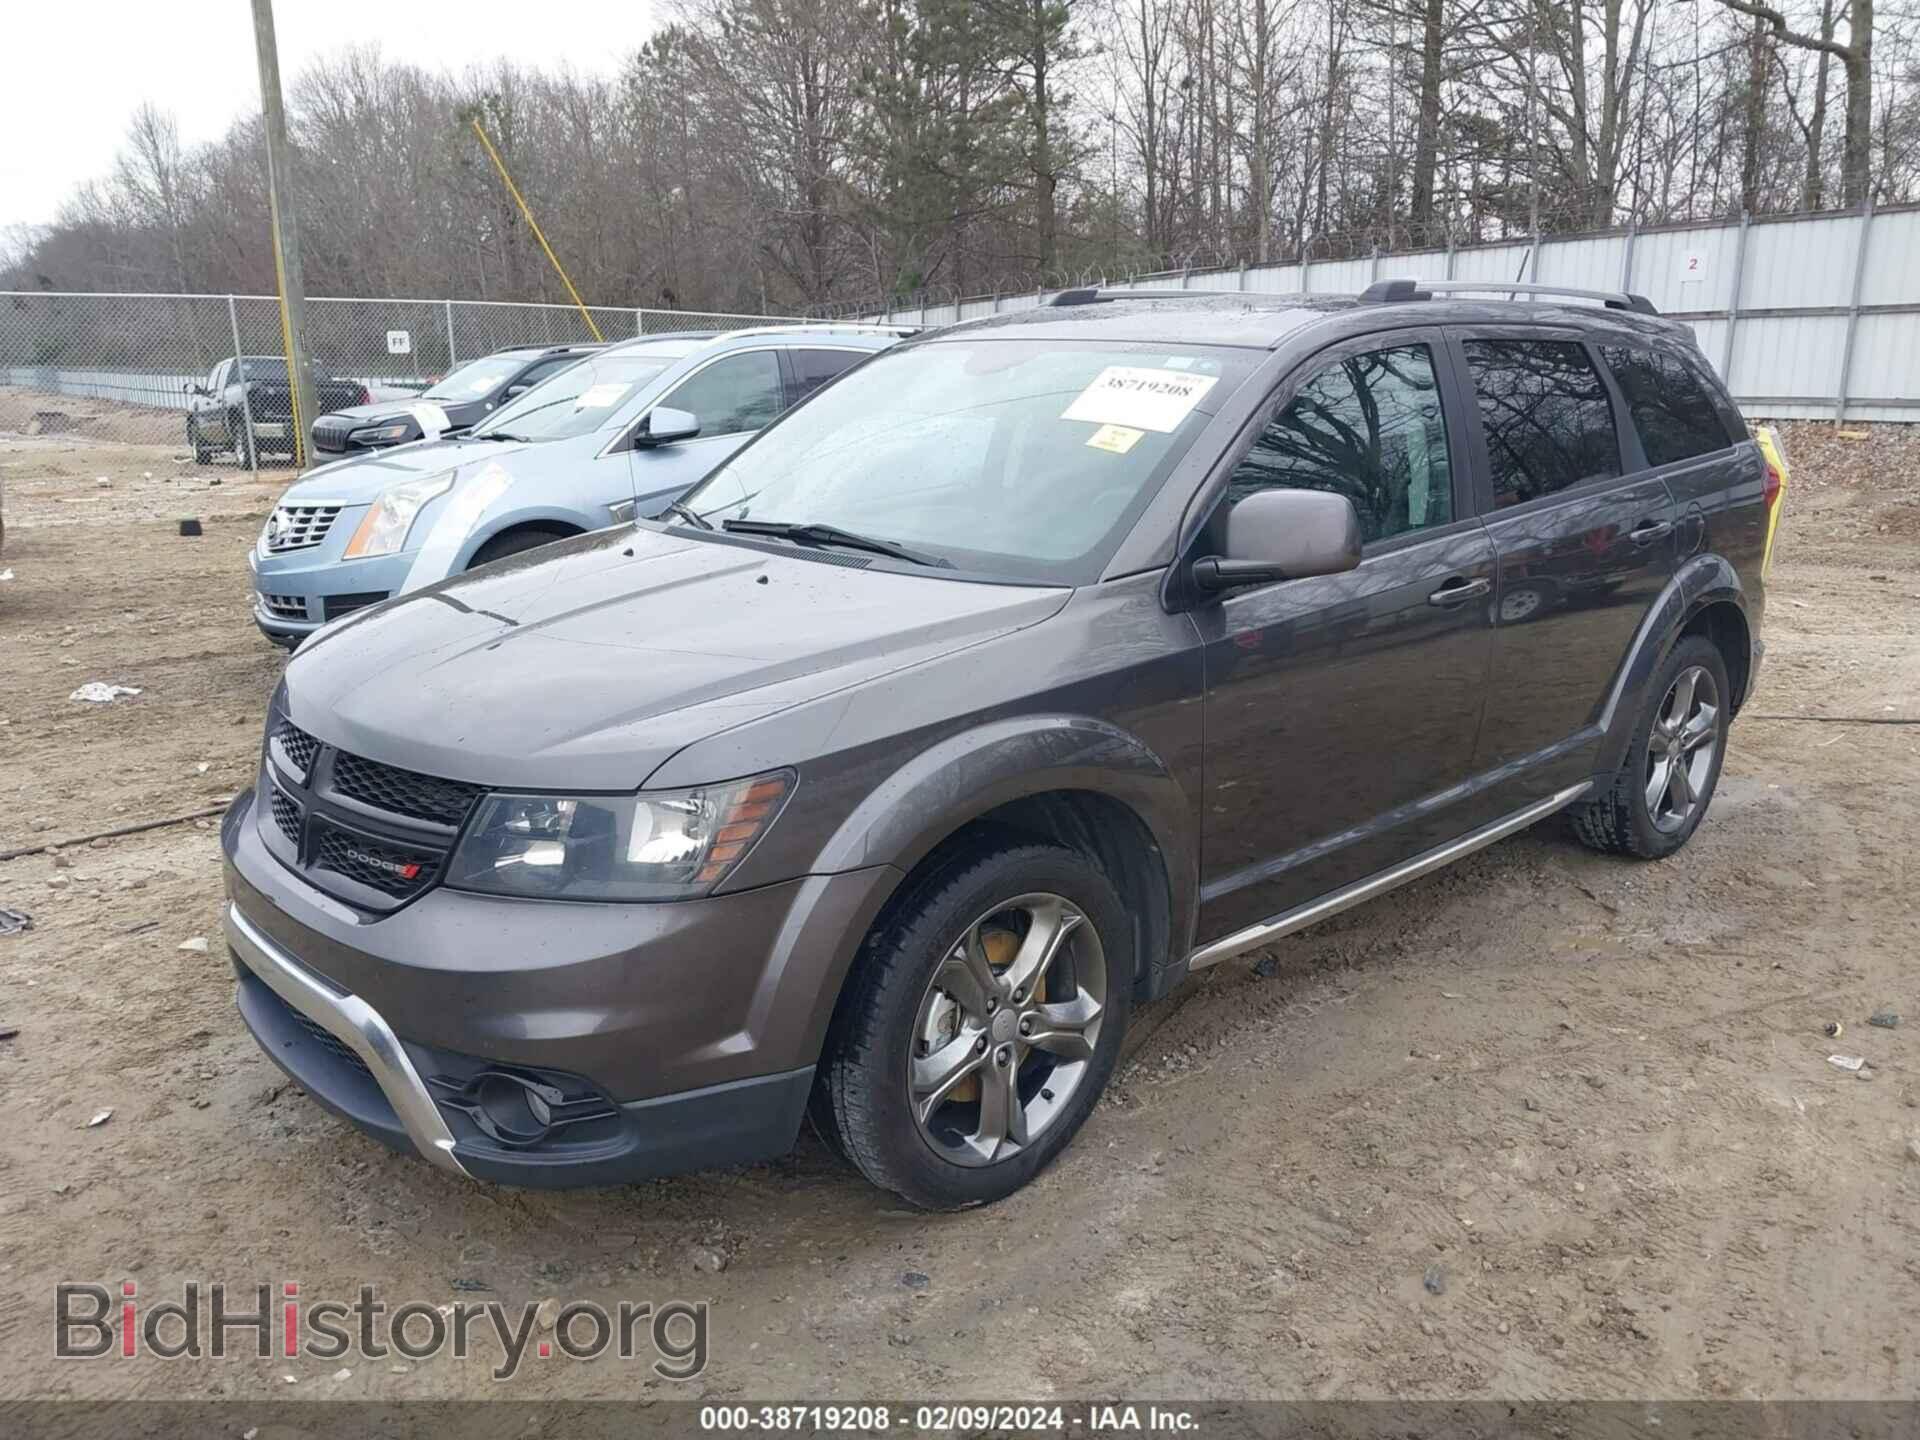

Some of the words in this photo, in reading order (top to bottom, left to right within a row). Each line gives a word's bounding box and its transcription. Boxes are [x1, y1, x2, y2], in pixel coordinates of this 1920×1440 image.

[1689, 258, 1698, 270] 2
[1107, 377, 1193, 397] 38719208
[347, 849, 406, 875] DODGE
